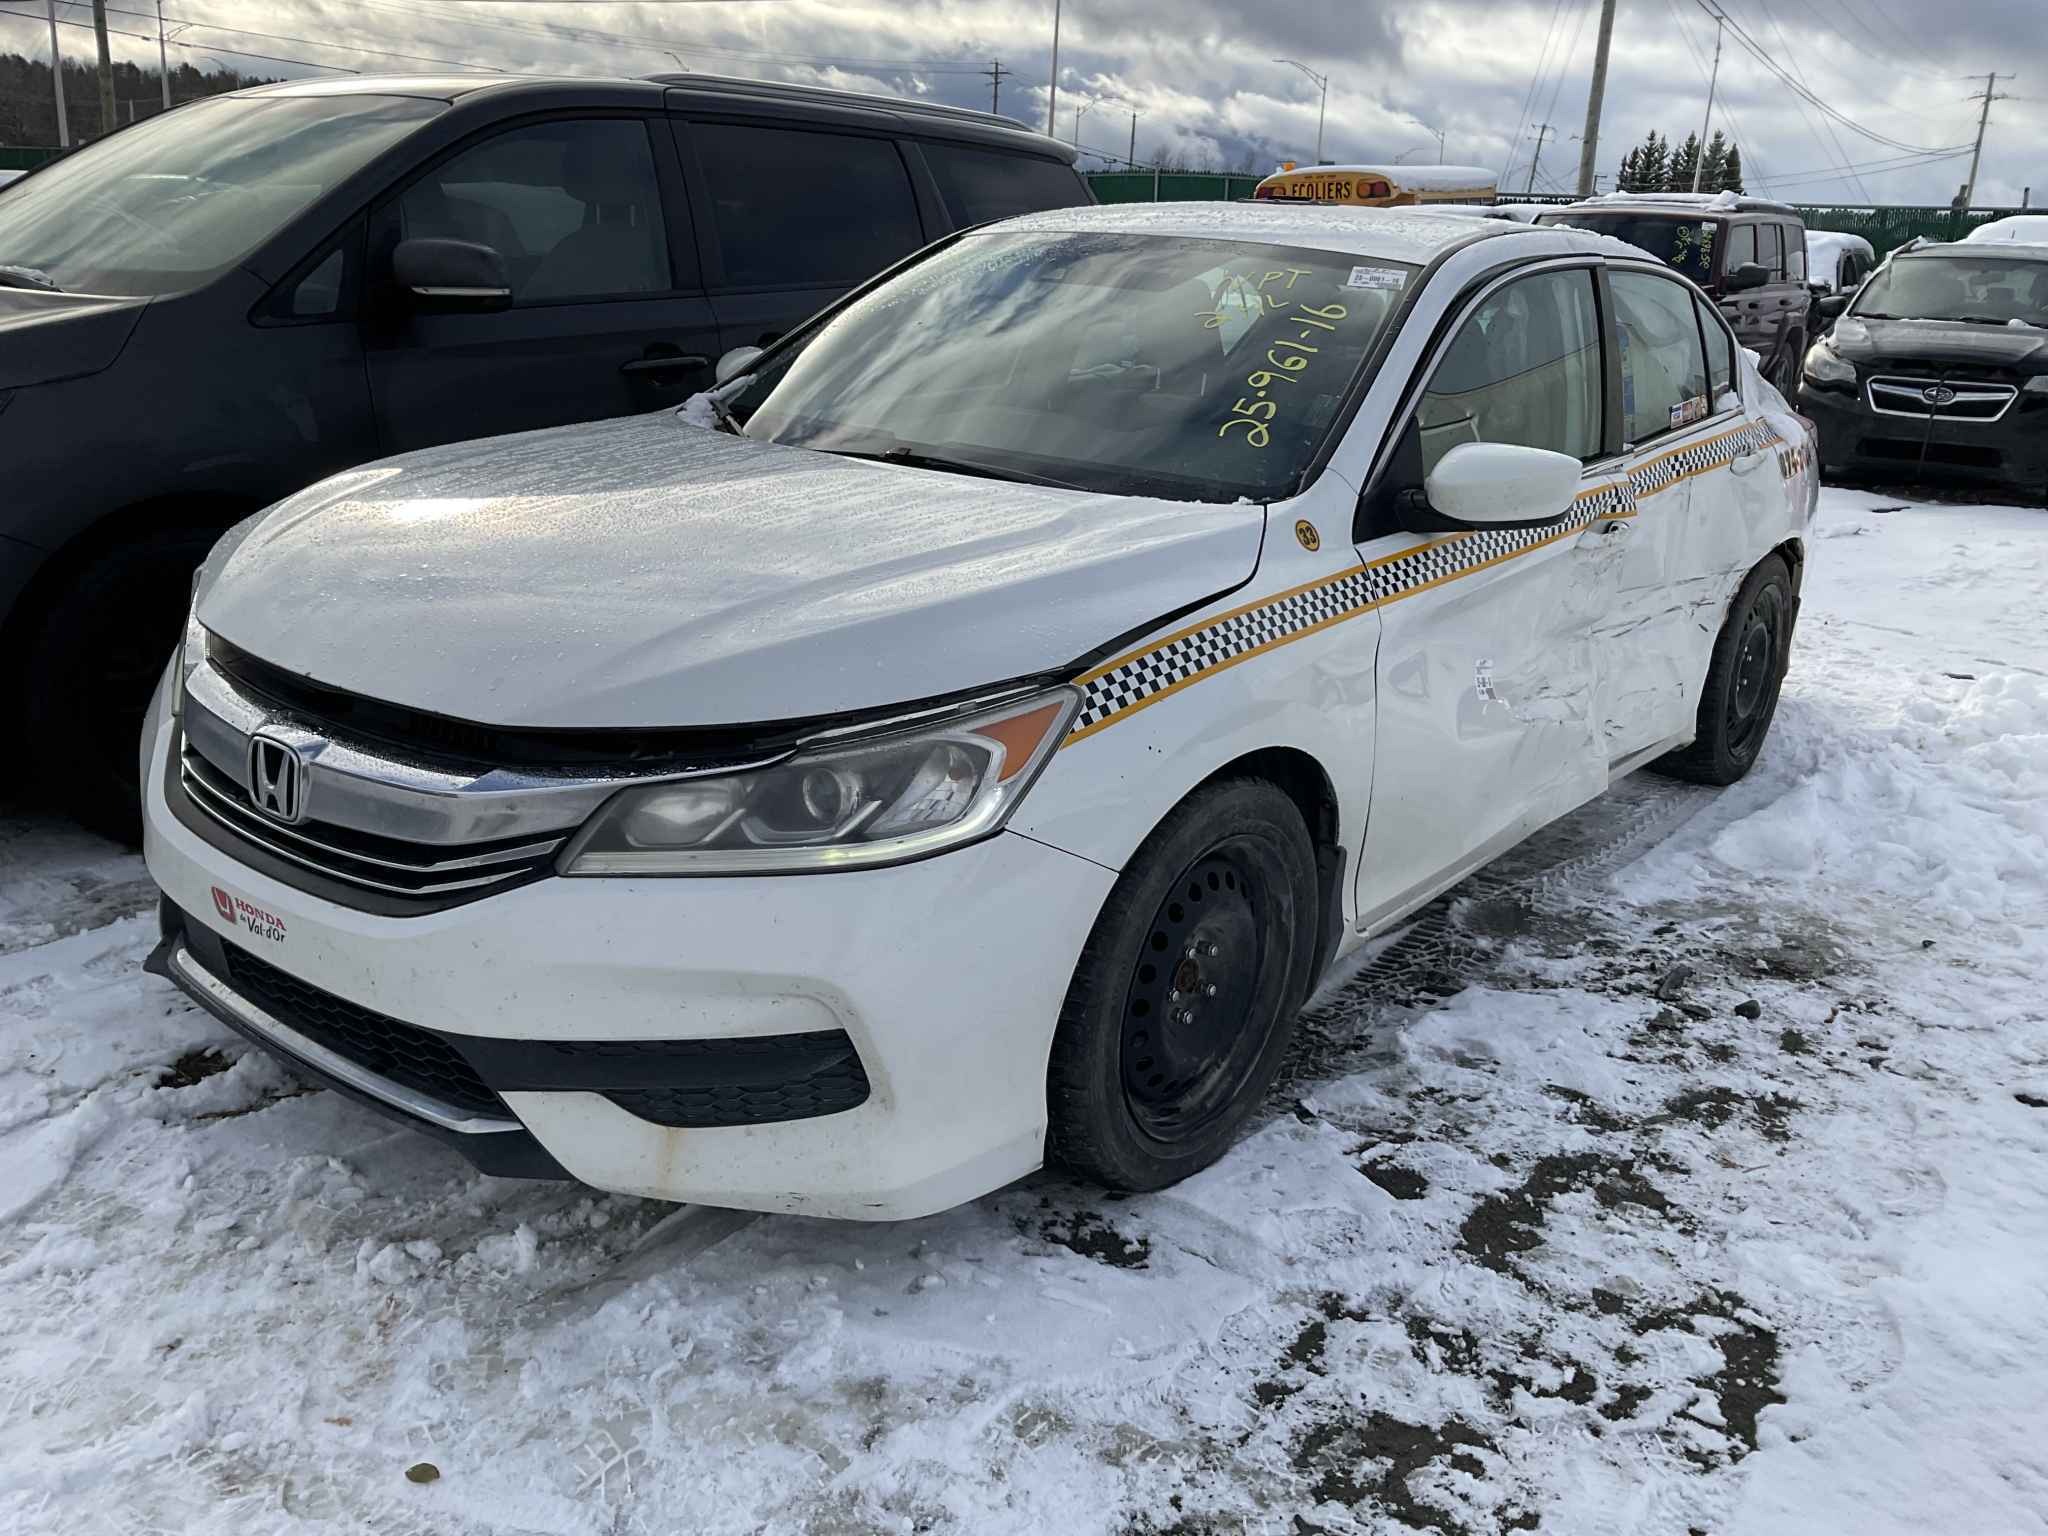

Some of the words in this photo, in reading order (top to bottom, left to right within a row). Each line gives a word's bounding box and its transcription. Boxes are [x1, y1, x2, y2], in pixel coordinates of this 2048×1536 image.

[1299, 525, 1317, 546] 33
[234, 897, 287, 931] HONDA
[247, 916, 286, 943] Val-d'Or
